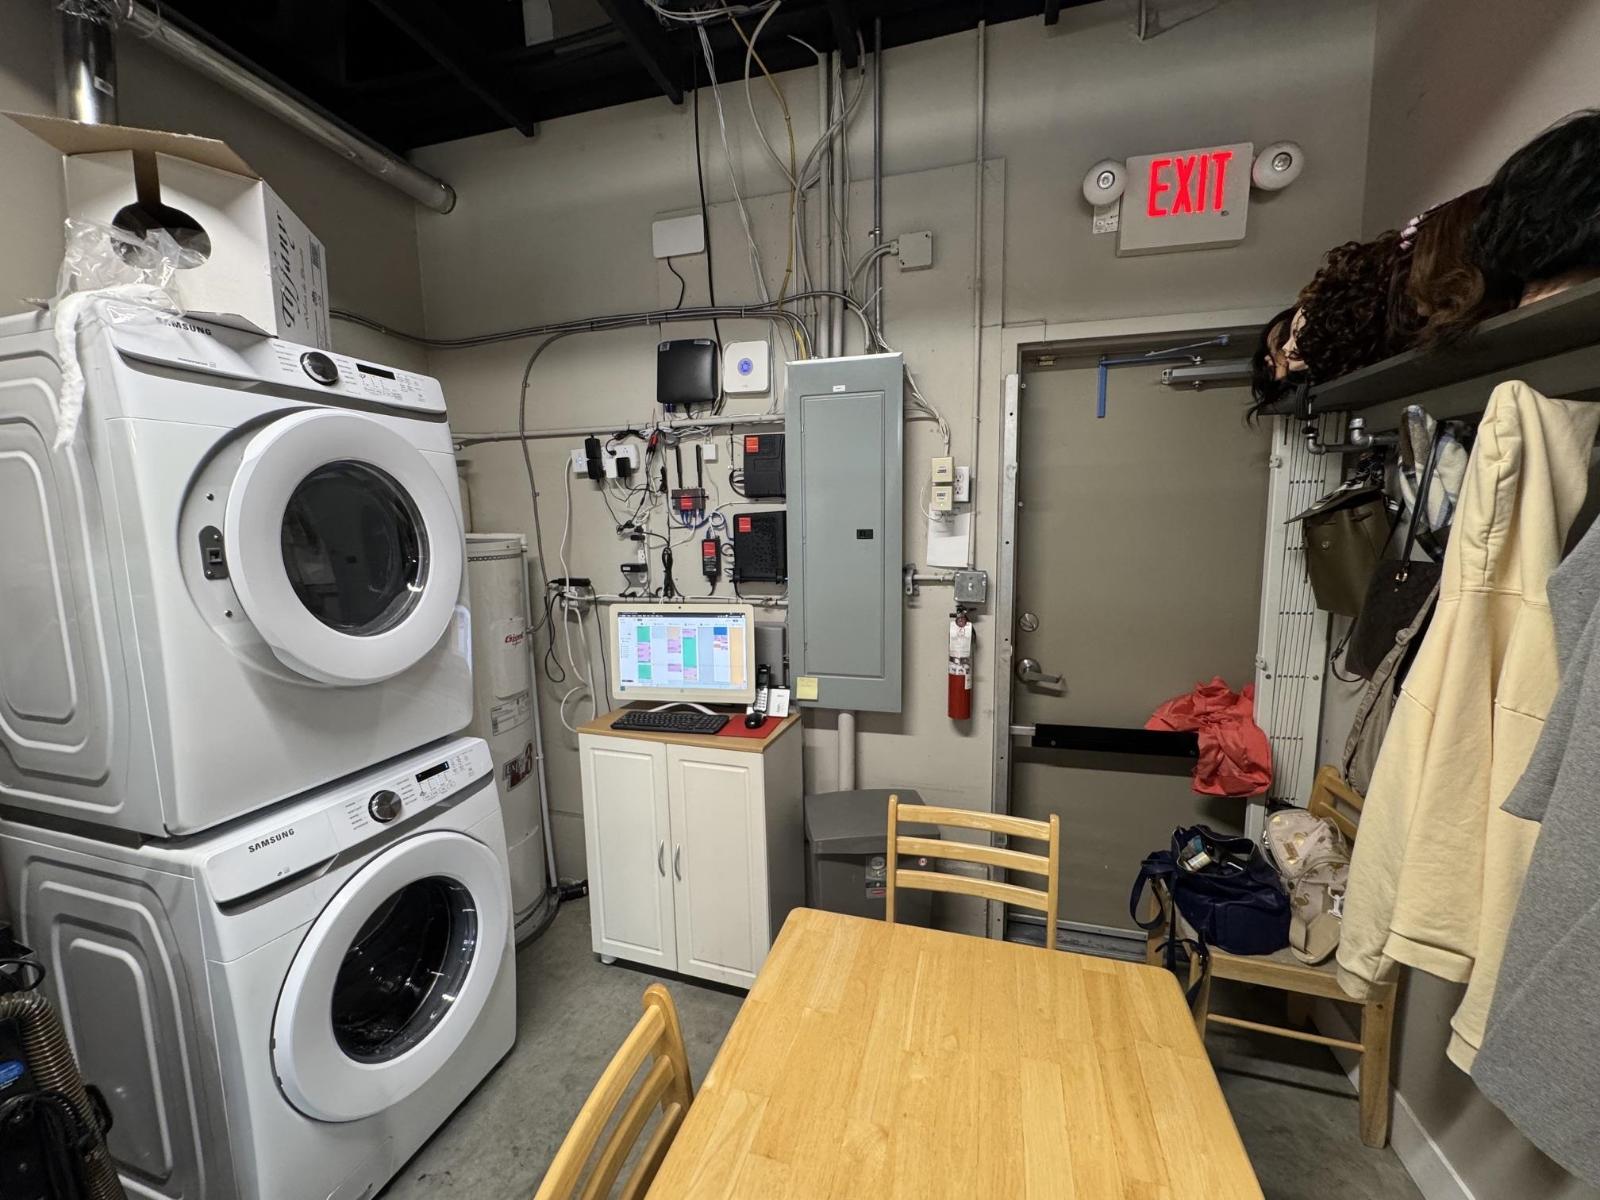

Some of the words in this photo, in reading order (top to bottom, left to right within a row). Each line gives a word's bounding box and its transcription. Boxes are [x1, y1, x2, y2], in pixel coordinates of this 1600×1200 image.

[1147, 150, 1233, 218] EXIT
[155, 316, 212, 336] MSUNG
[248, 828, 295, 852] SAMSUNG
